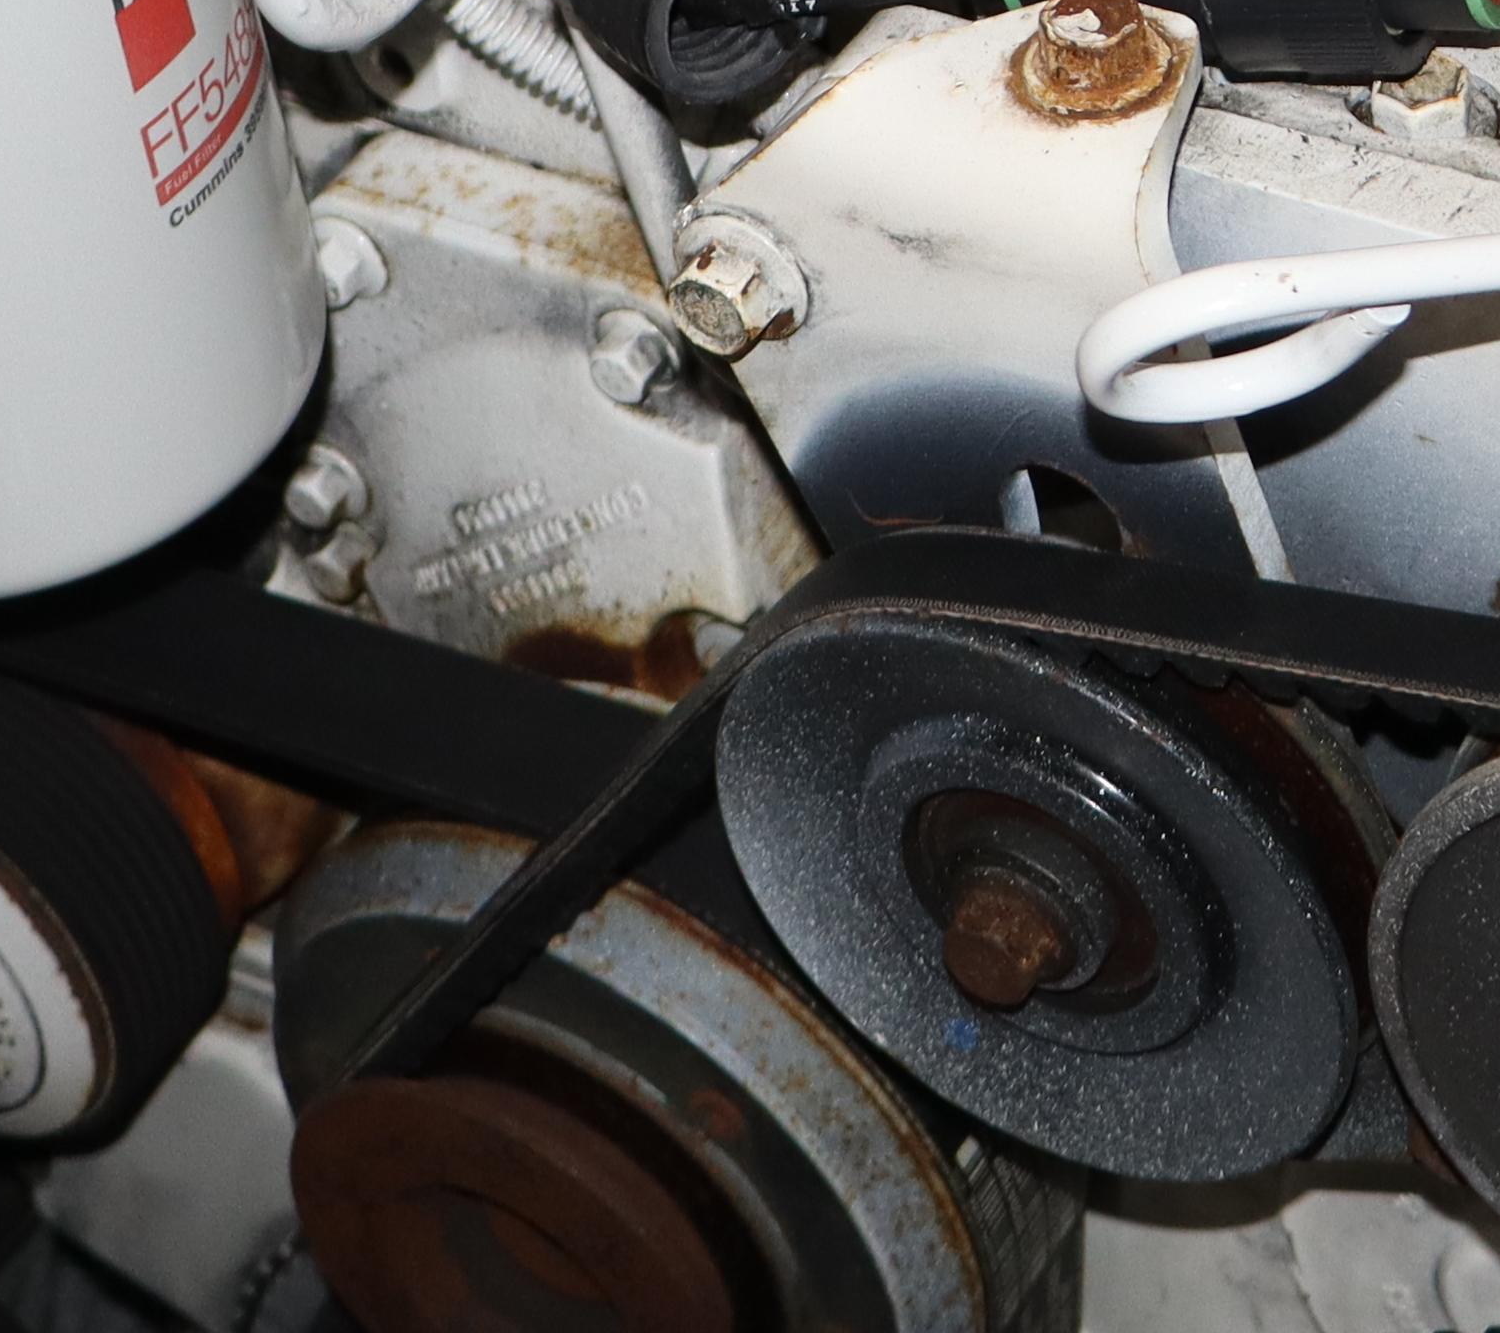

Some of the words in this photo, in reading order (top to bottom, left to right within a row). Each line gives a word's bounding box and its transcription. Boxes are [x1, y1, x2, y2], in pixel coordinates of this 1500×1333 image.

[164, 162, 194, 196] Fuel
[194, 132, 223, 170] Filter
[169, 141, 245, 229] Cummins
